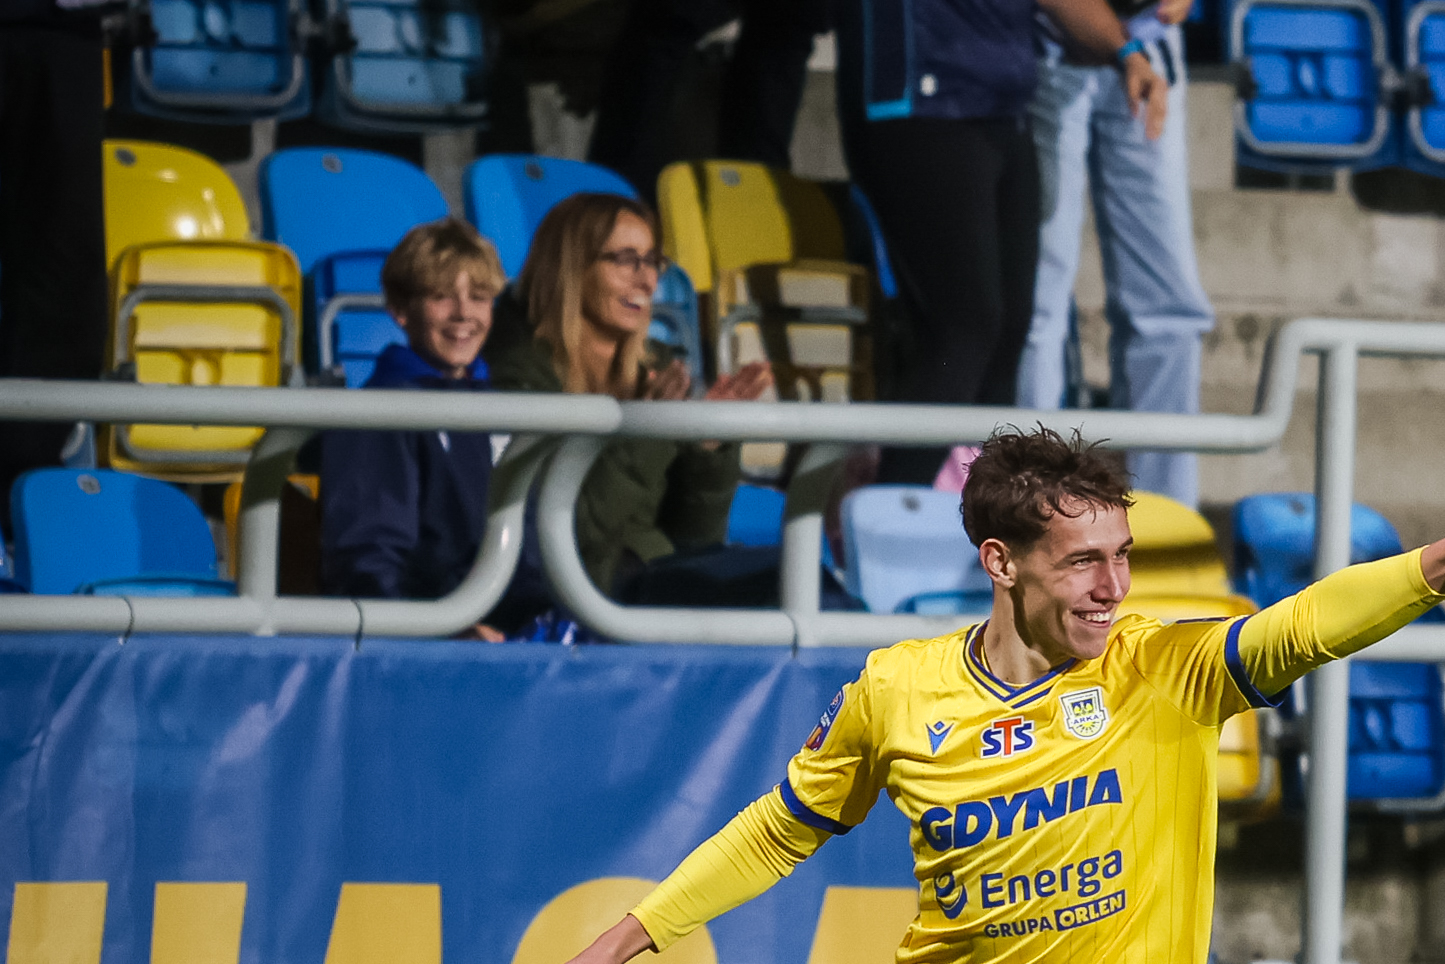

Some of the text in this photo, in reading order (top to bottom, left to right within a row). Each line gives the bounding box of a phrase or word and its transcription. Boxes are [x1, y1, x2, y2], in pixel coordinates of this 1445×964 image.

[981, 716, 1033, 757] STS
[1073, 714, 1099, 725] ARKA
[920, 768, 1122, 852] GDYNIA
[981, 850, 1122, 909] Energa
[984, 892, 1125, 938] GRUPA ORLEN
